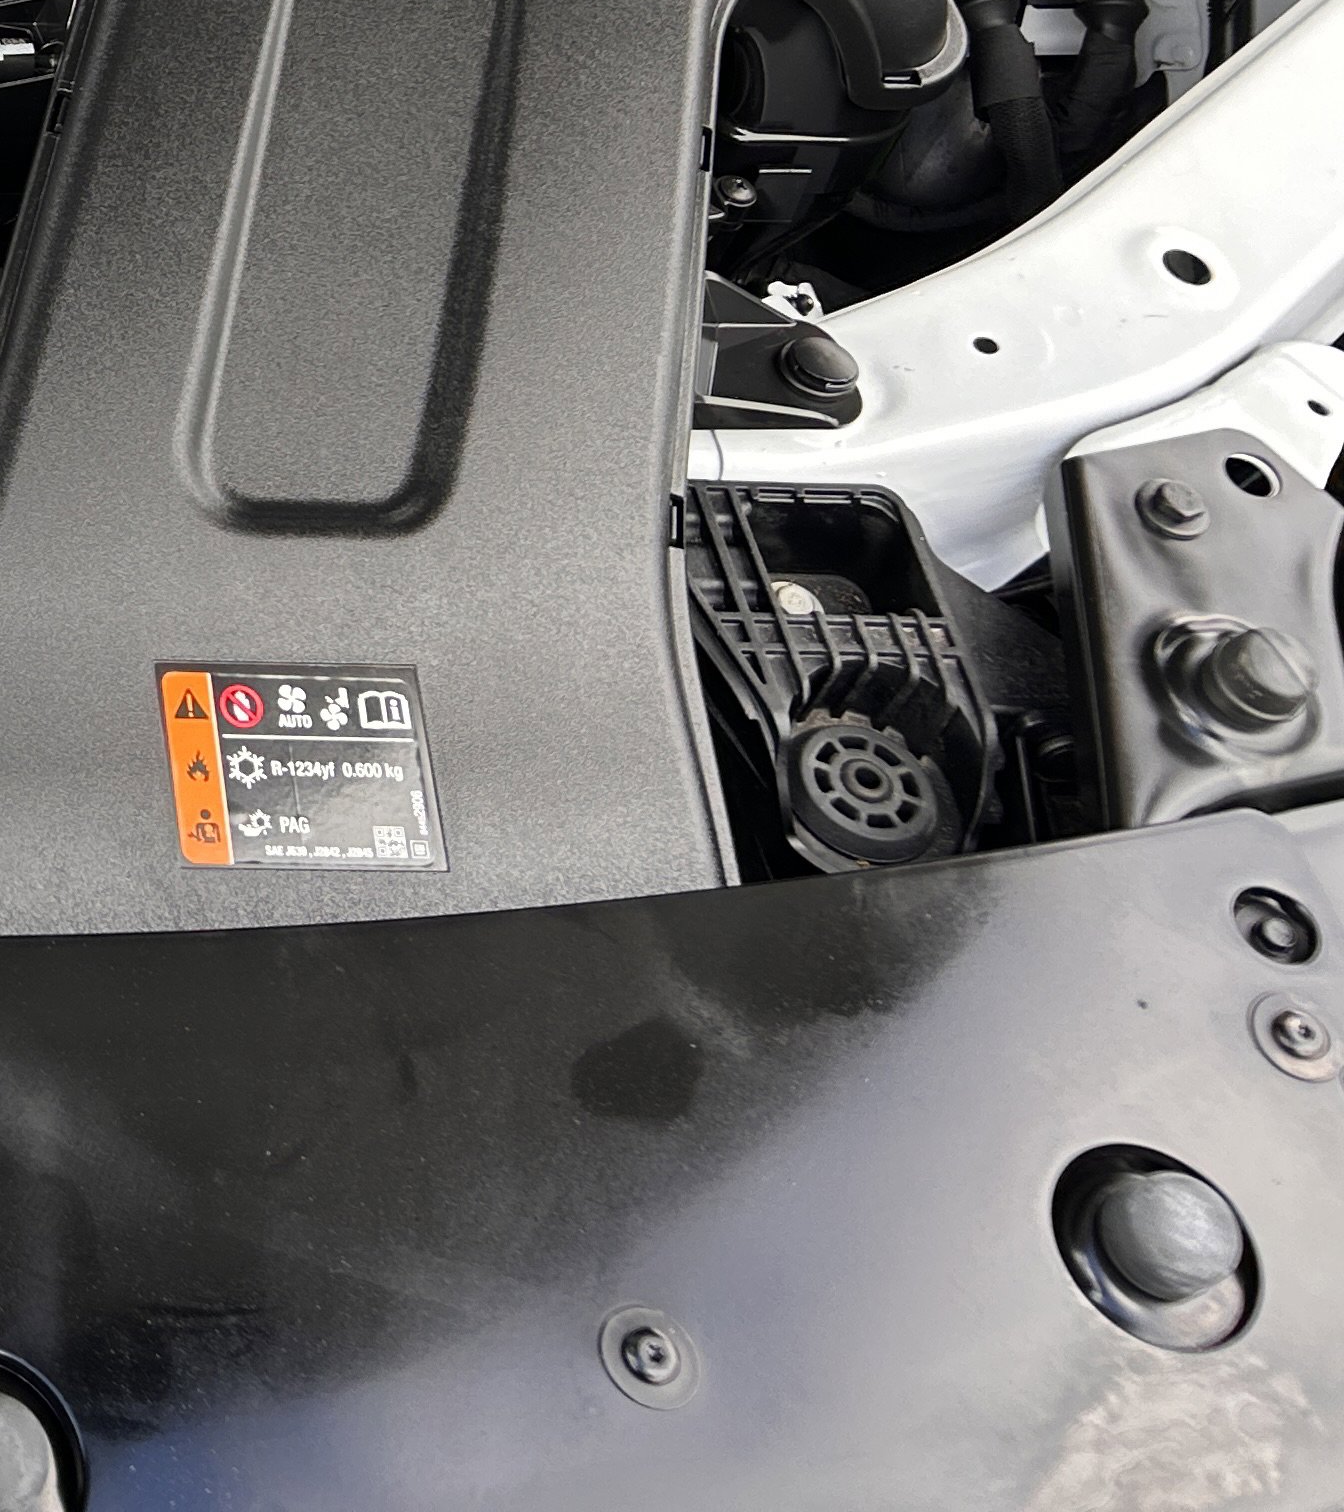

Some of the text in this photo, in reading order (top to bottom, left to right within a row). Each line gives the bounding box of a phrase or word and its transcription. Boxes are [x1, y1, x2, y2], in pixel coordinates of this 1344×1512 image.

[278, 713, 312, 729] AUTO
[270, 759, 404, 782] R-1234yf 0.600 kg
[279, 816, 311, 834] PAG
[265, 845, 284, 857] SAE
